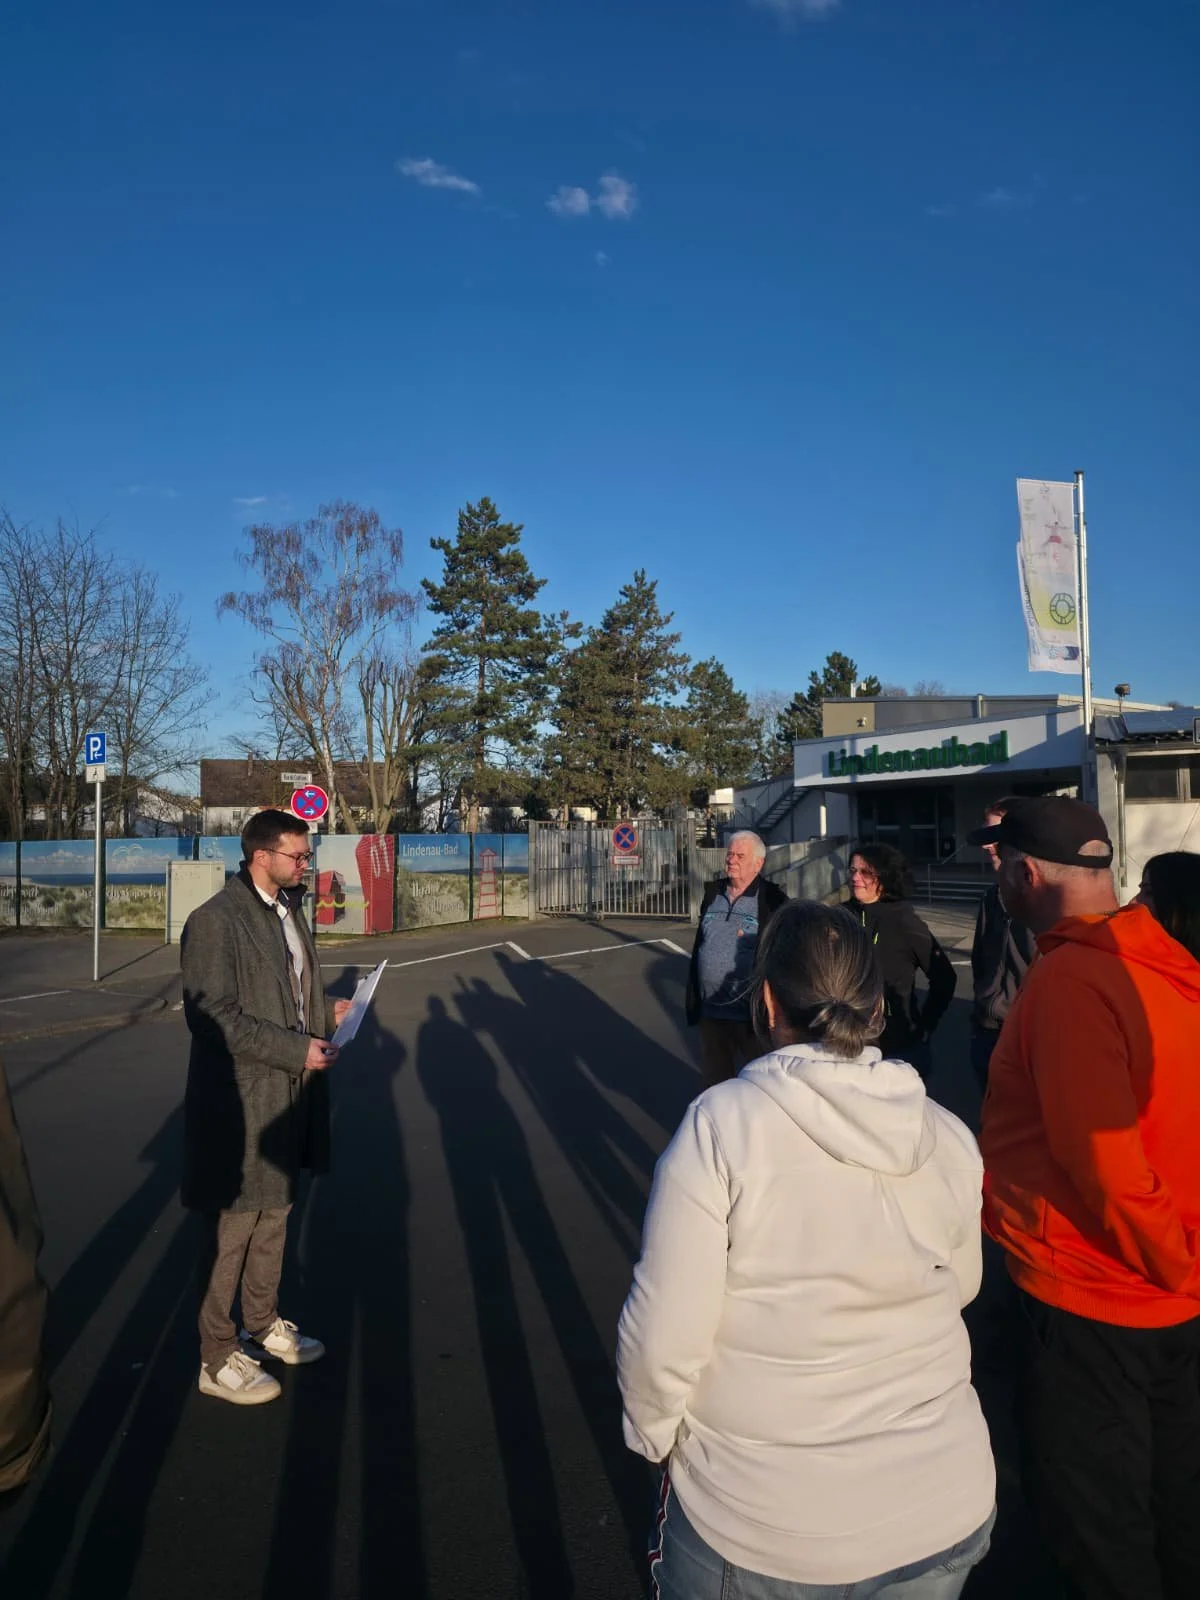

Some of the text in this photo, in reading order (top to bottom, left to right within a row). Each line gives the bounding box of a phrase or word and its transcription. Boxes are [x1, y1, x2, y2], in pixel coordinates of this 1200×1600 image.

[90, 736, 102, 761] P
[828, 730, 1009, 777] Lindenaubad
[402, 843, 459, 857] Lindenau-Bad
